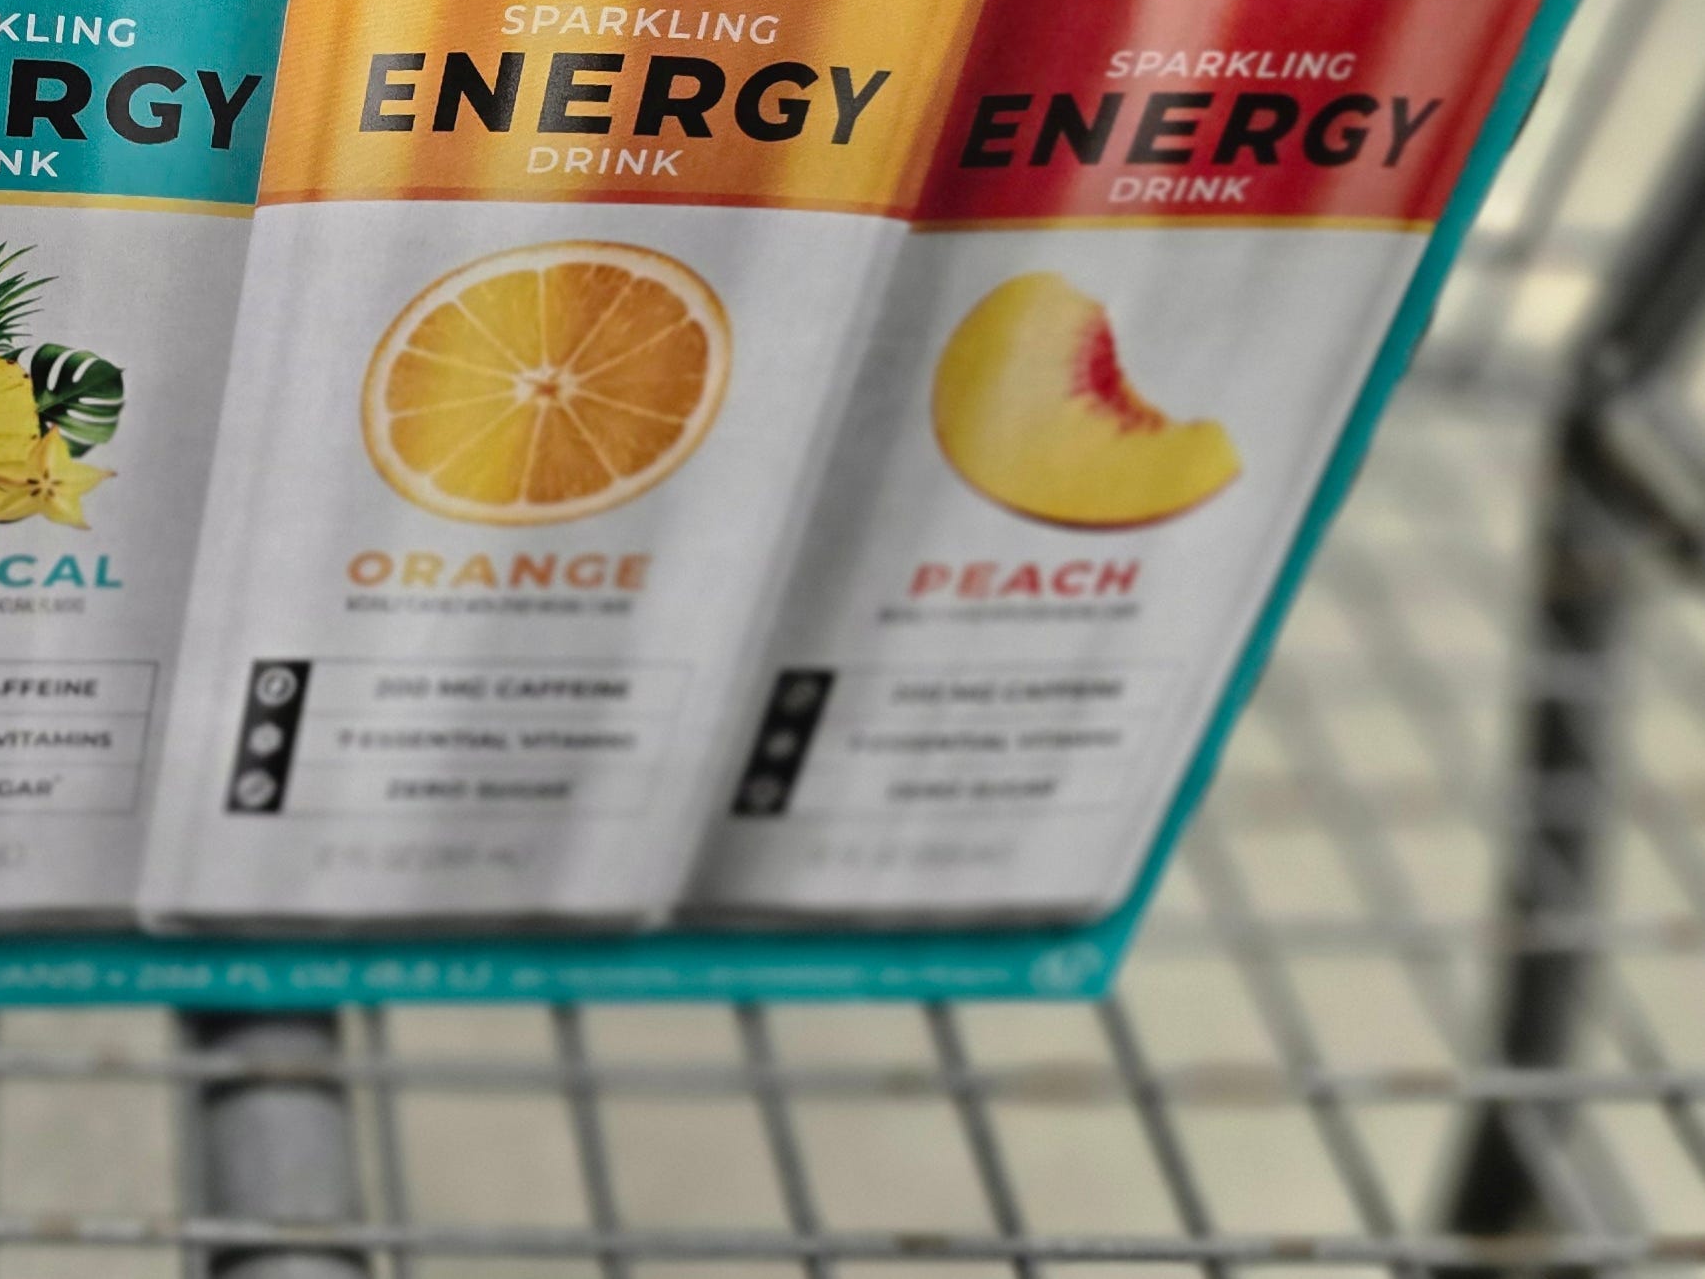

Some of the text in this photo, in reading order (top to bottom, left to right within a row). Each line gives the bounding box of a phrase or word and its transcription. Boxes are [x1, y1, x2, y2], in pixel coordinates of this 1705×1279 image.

[501, 5, 779, 44] SPARKLING
[1106, 51, 1356, 82] SPARKLING
[359, 52, 892, 144] ENERGY
[962, 93, 1441, 168] ENERGY
[526, 146, 684, 178] DRINK
[1108, 174, 1251, 205] DRINK
[347, 550, 653, 590] ORANGE
[906, 559, 1141, 599] PEACH
